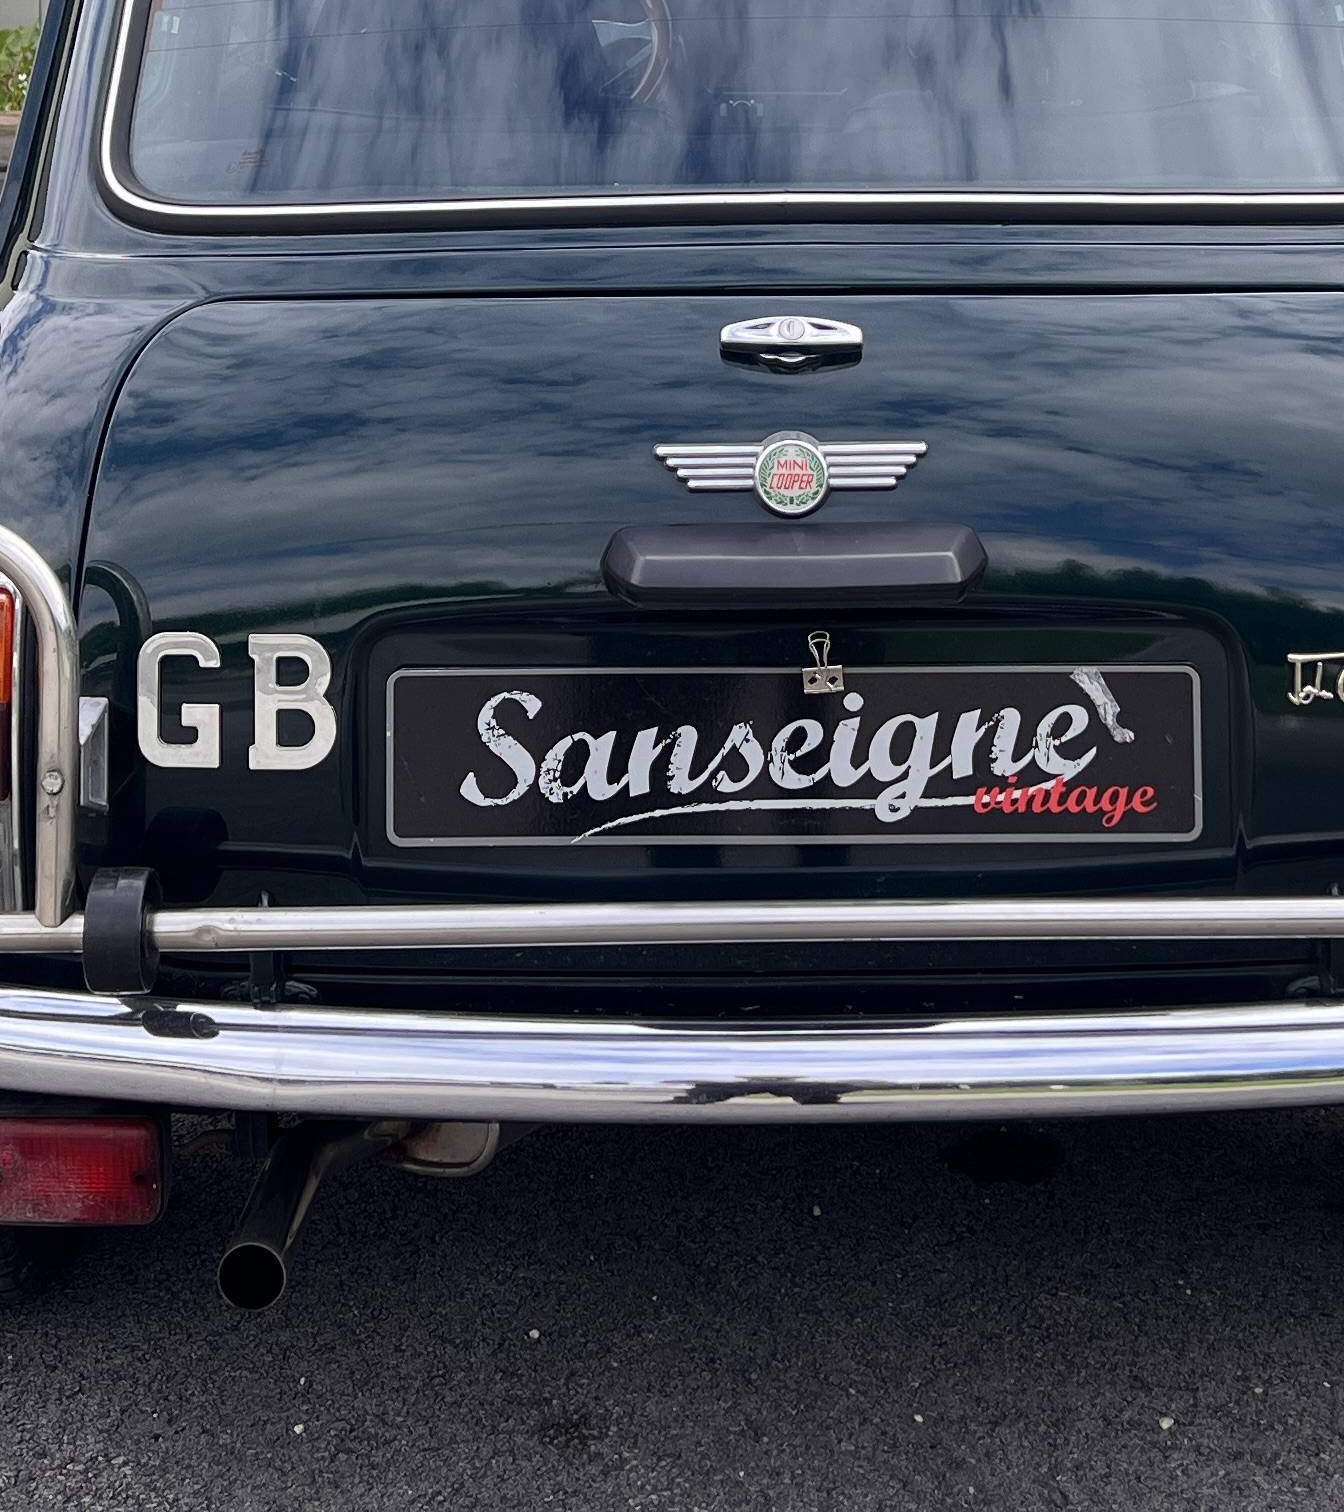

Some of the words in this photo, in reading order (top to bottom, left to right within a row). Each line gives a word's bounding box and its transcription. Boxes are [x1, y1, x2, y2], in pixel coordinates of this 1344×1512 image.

[769, 473, 814, 490] COOPER
[776, 459, 808, 471] MINI
[137, 631, 337, 771] GB
[459, 691, 1097, 824] Sanseigne
[973, 775, 1157, 827] vintage
